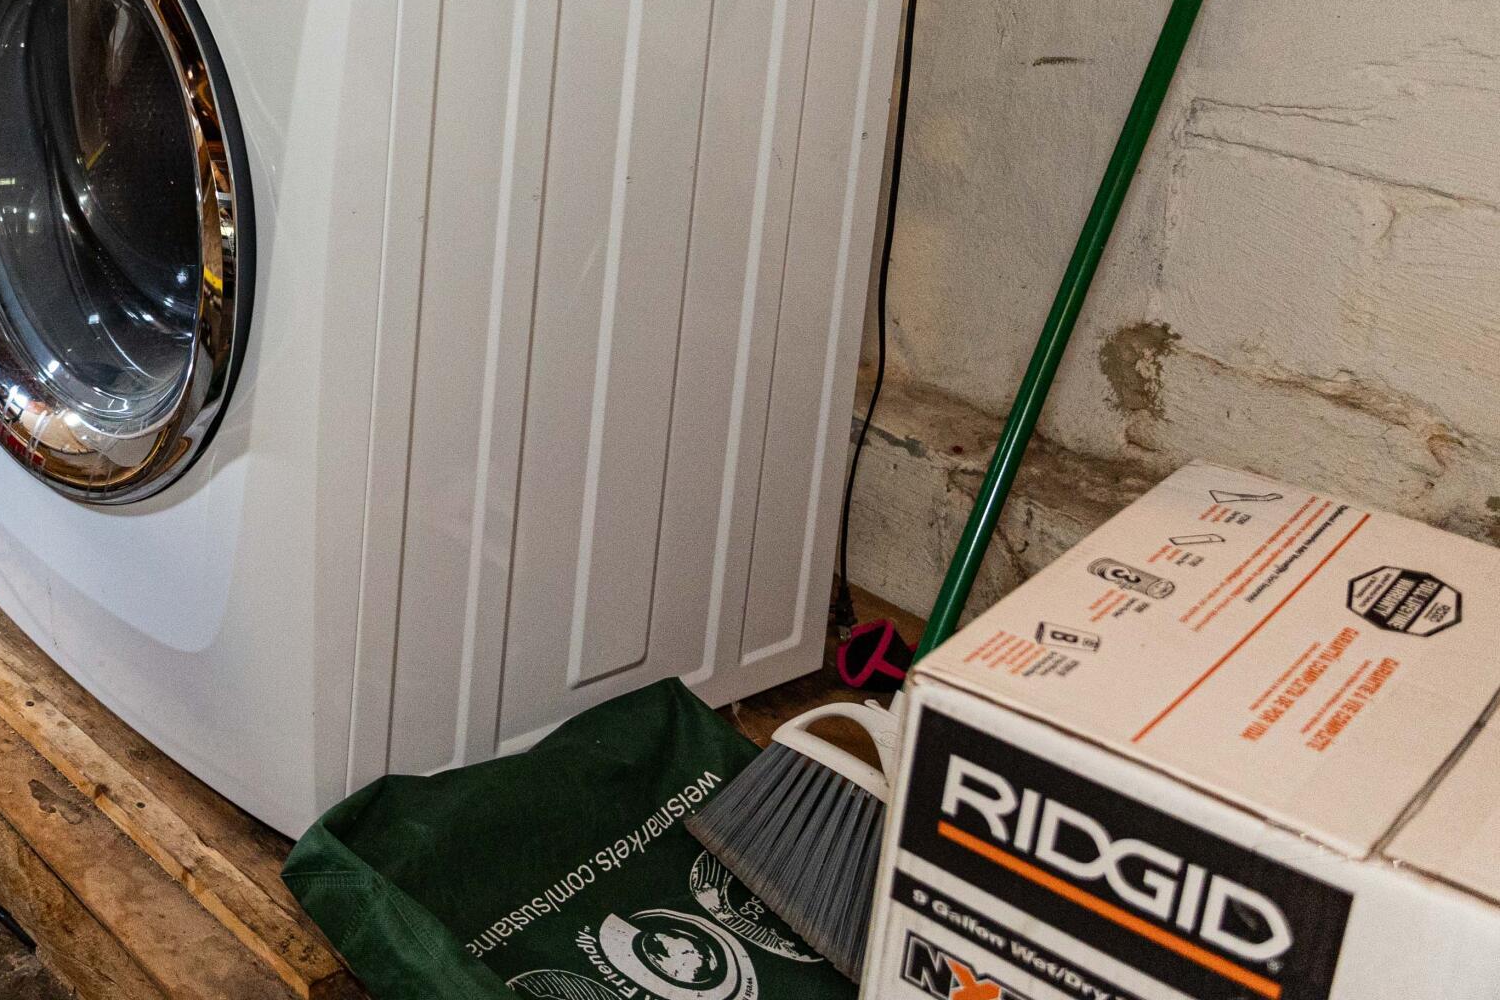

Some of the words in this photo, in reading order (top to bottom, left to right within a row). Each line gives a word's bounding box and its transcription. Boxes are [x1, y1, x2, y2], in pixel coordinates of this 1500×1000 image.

[1370, 576, 1416, 617] WARRANTY
[1385, 595, 1425, 630] LIFETIME
[1410, 577, 1440, 601] FULL
[940, 753, 1293, 962] RIDGID
[575, 930, 639, 999] Friendly
[932, 899, 1007, 949] Gallon
[1010, 940, 1112, 1000] Wet/Dry
